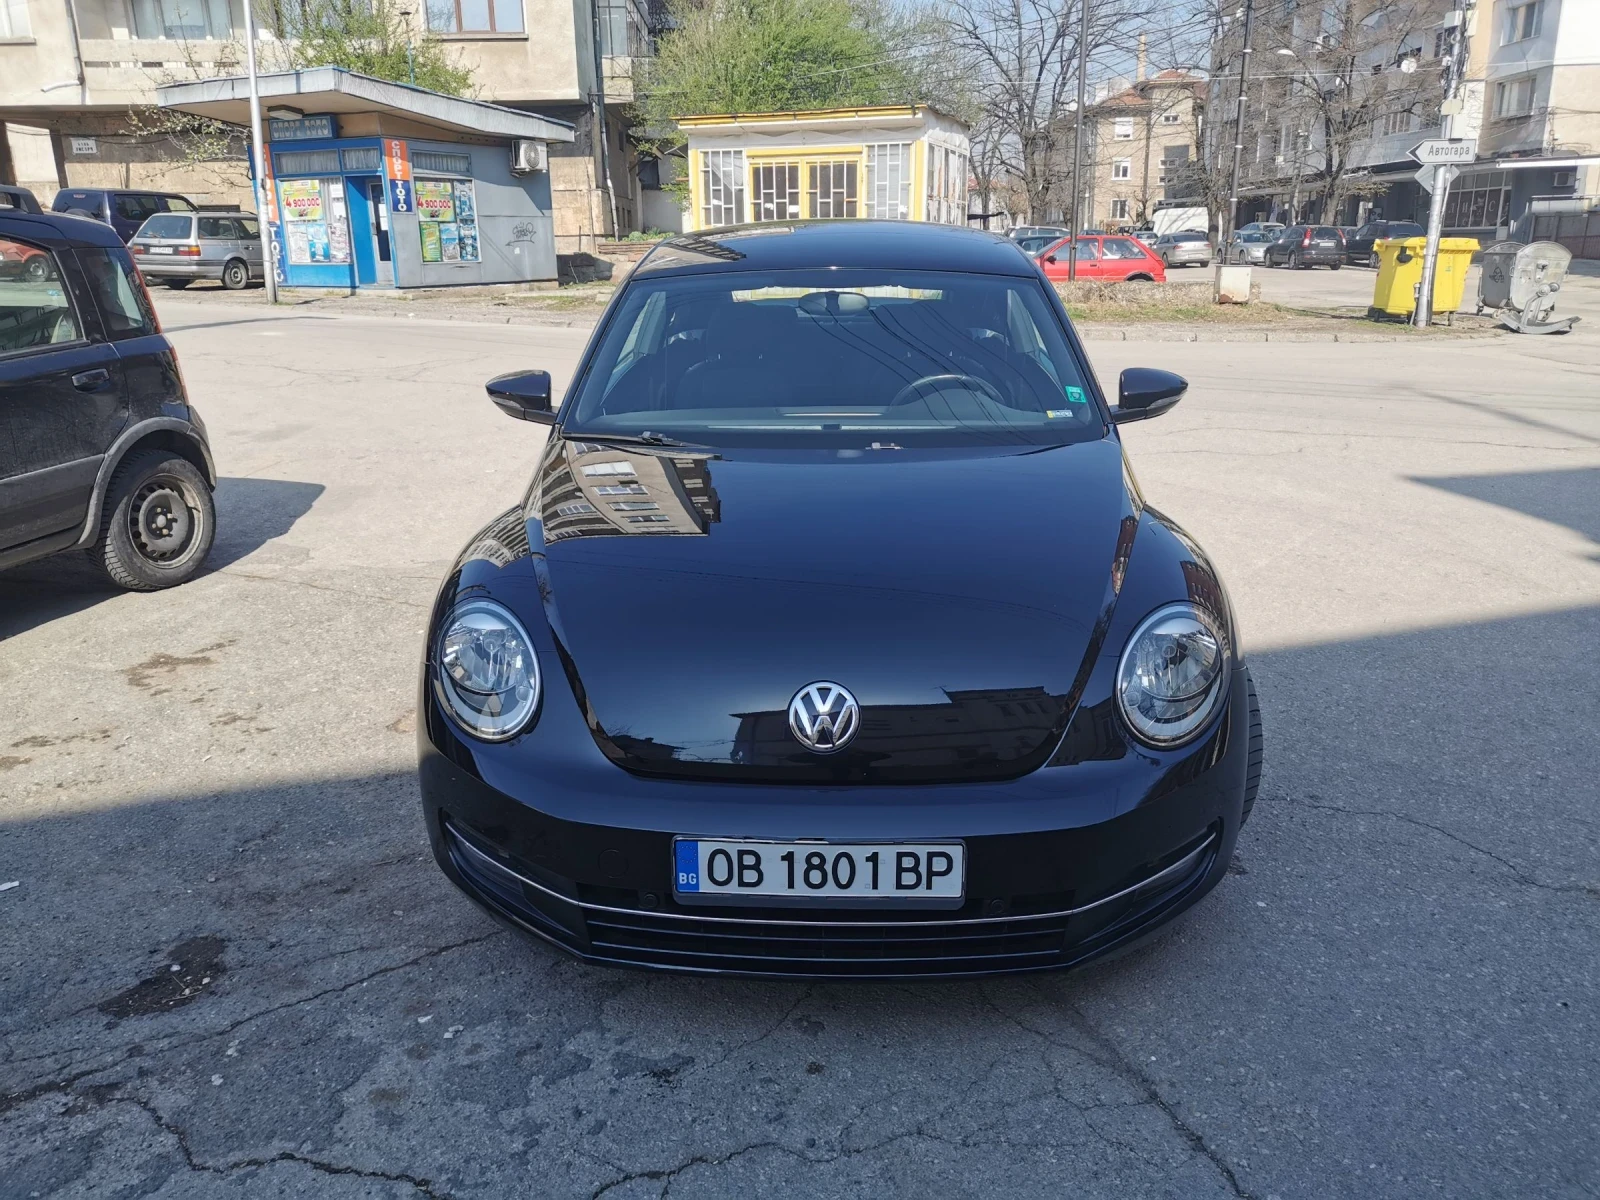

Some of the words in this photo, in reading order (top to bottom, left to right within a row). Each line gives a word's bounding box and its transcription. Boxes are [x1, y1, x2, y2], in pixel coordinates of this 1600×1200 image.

[1428, 145, 1470, 159] Автогара
[391, 140, 403, 180] СПОРТ
[293, 198, 306, 208] 900
[395, 181, 407, 212] ТОТО
[417, 195, 424, 208] 4
[425, 199, 438, 209] 900
[707, 848, 764, 888] OB
[780, 850, 879, 890] 1801
[895, 851, 954, 890] BP
[679, 872, 697, 885] BG
